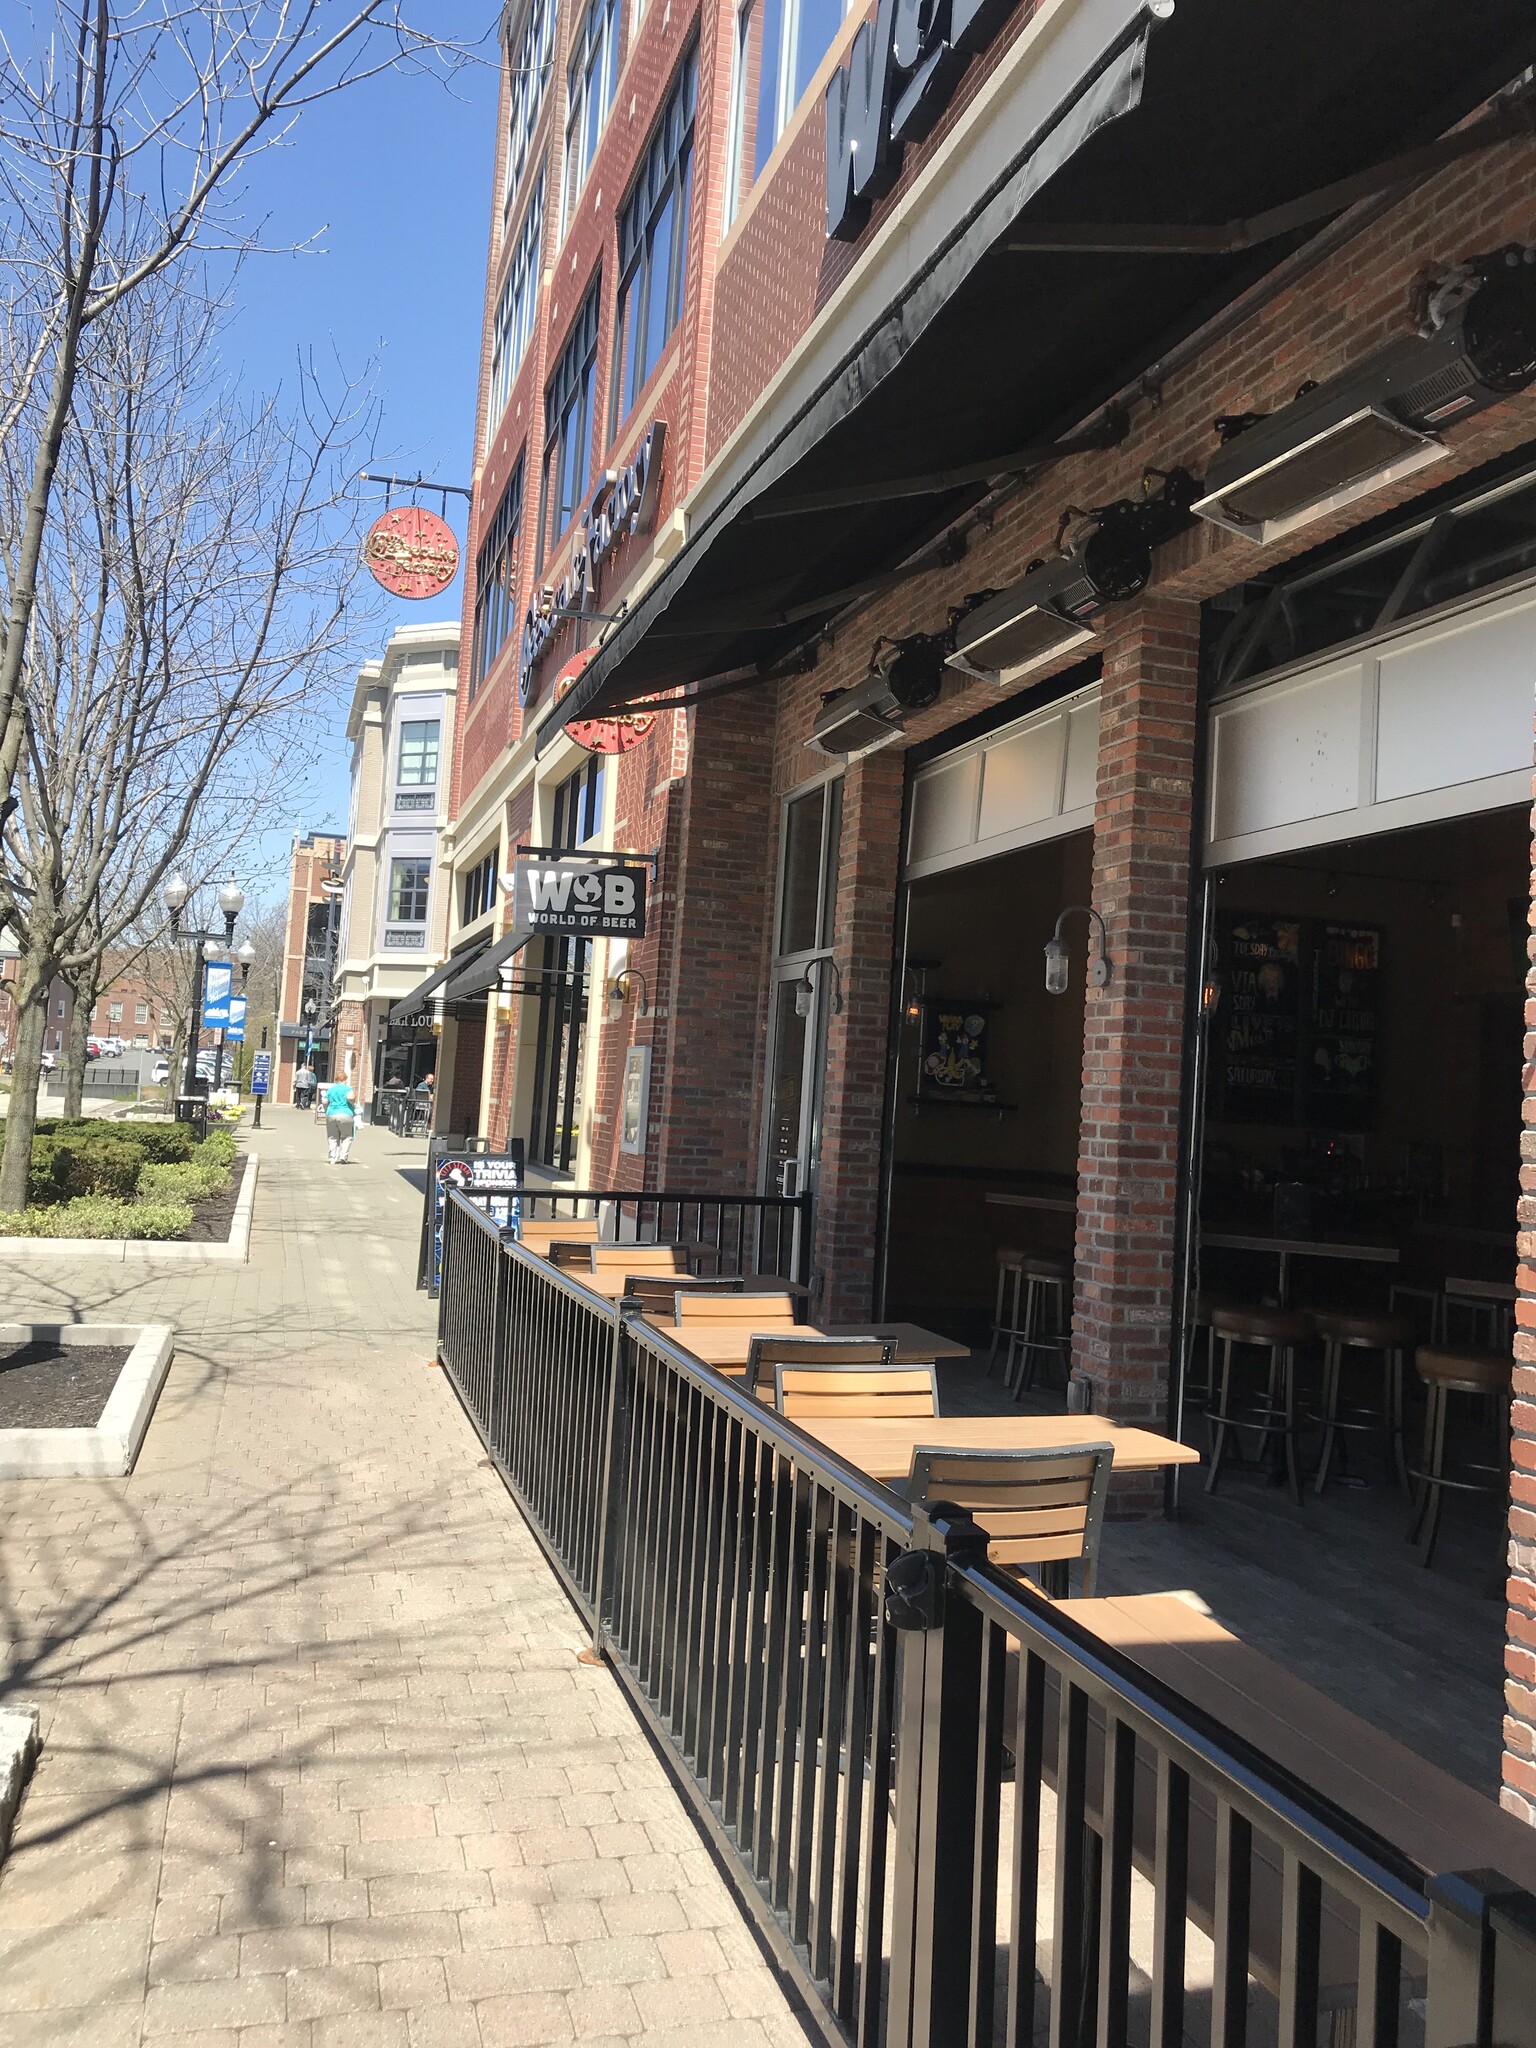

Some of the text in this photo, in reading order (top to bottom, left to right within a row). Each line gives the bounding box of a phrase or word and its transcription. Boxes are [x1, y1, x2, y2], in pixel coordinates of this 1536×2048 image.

[580, 419, 667, 614] Factory
[527, 912, 637, 929] WORLD OF BEER
[473, 1161, 516, 1170] IS YOUR
[473, 1169, 517, 1180] TRIVIA
[473, 1179, 517, 1187] SPONSOR
